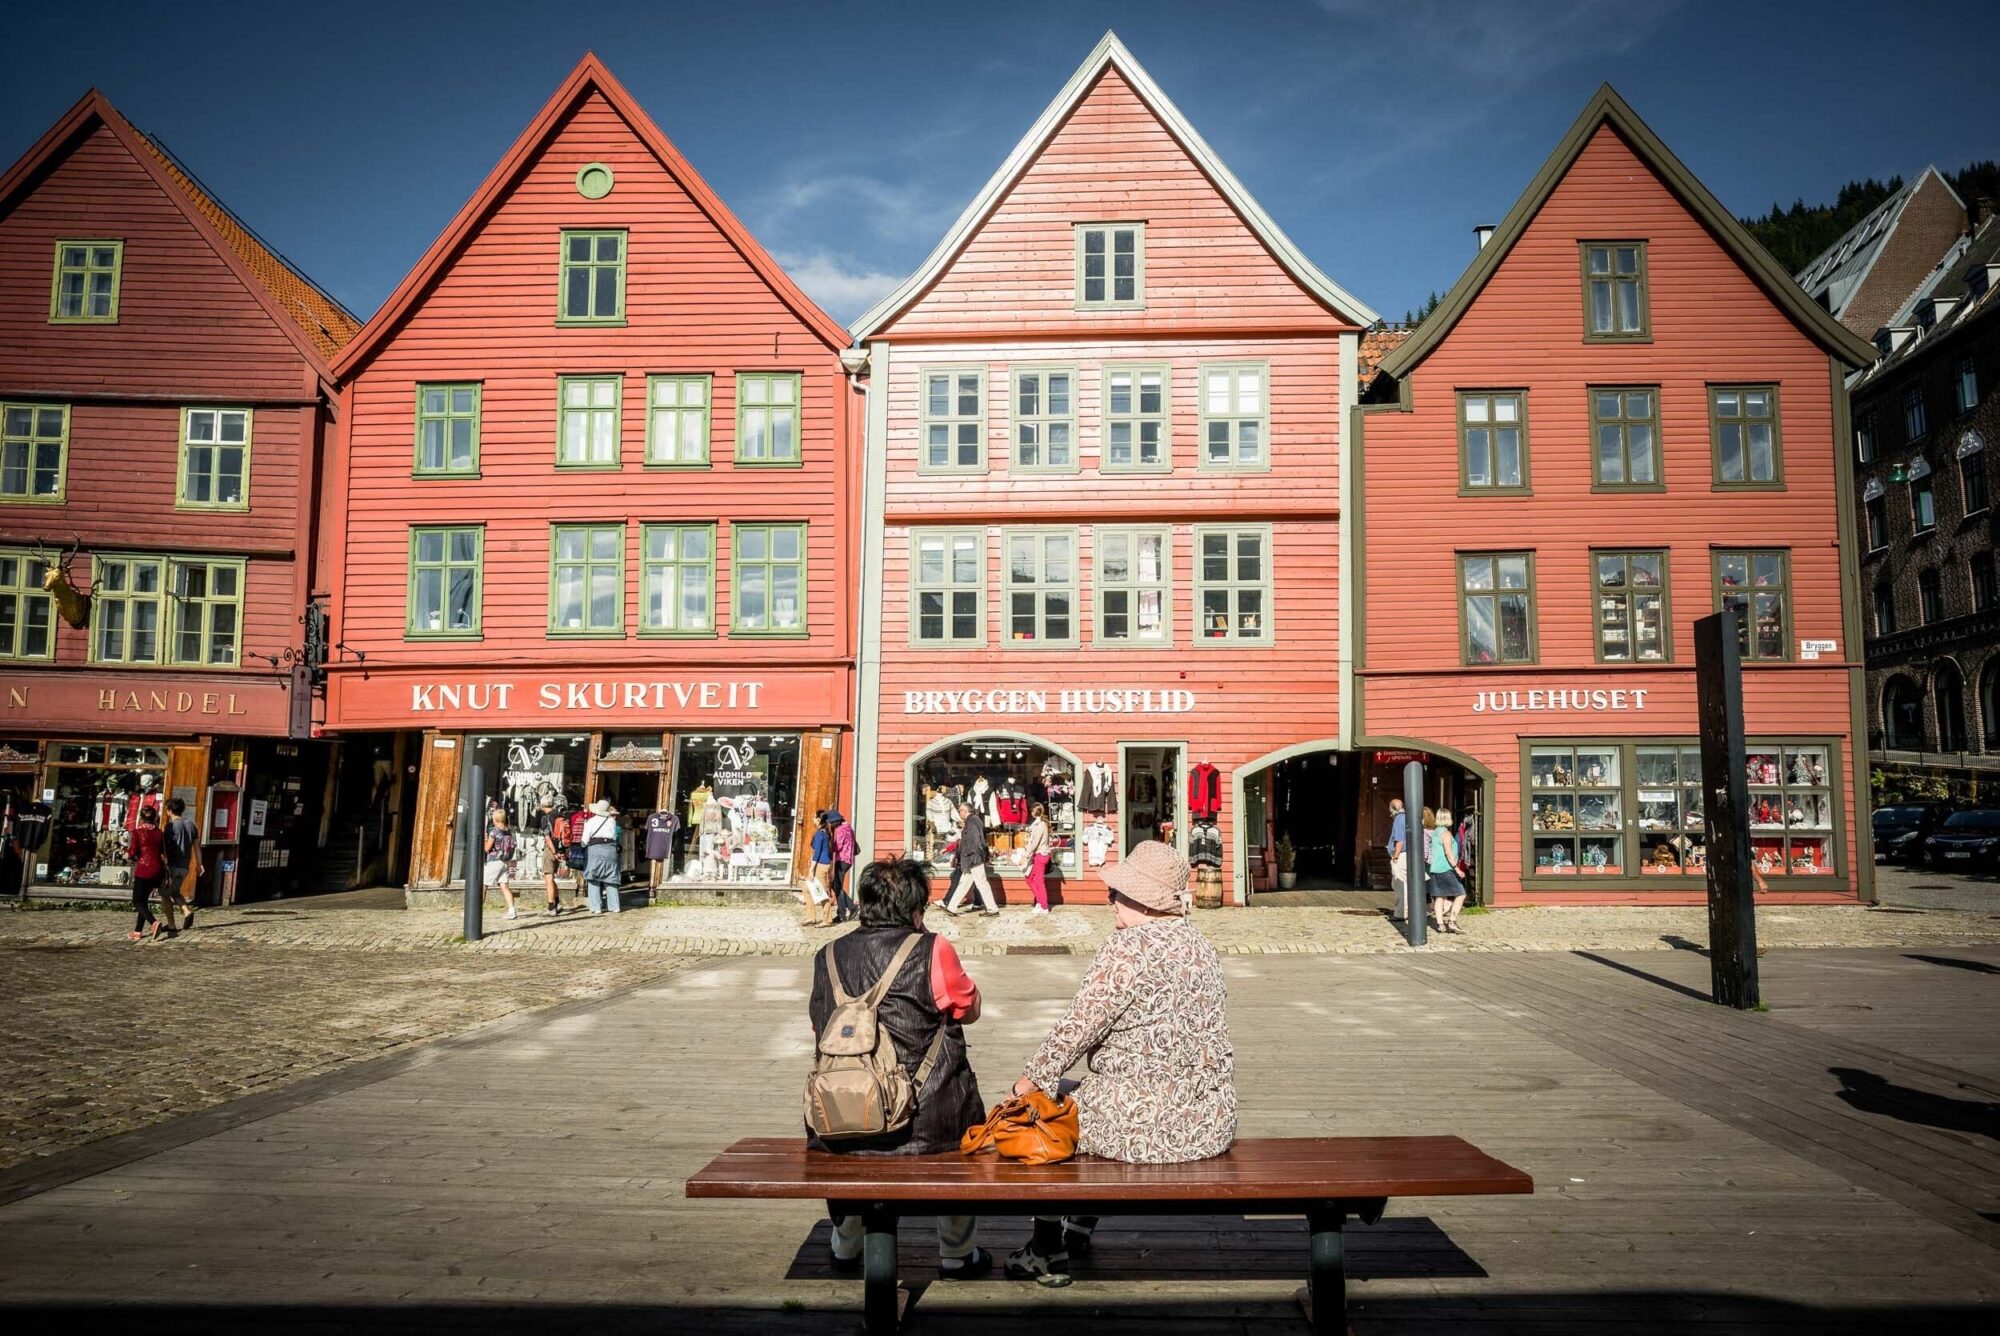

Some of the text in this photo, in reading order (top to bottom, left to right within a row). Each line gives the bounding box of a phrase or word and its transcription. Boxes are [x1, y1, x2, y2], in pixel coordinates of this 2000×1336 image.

[1806, 642, 1832, 651] Bryggen
[98, 688, 247, 715] HANDEL
[411, 682, 764, 711] KNUT SKURTVEIT
[904, 689, 1196, 713] BRYGGEN HUSFLID
[1472, 689, 1648, 712] JULEHUSET
[713, 771, 752, 779] AUDHILD
[651, 818, 659, 828] 3
